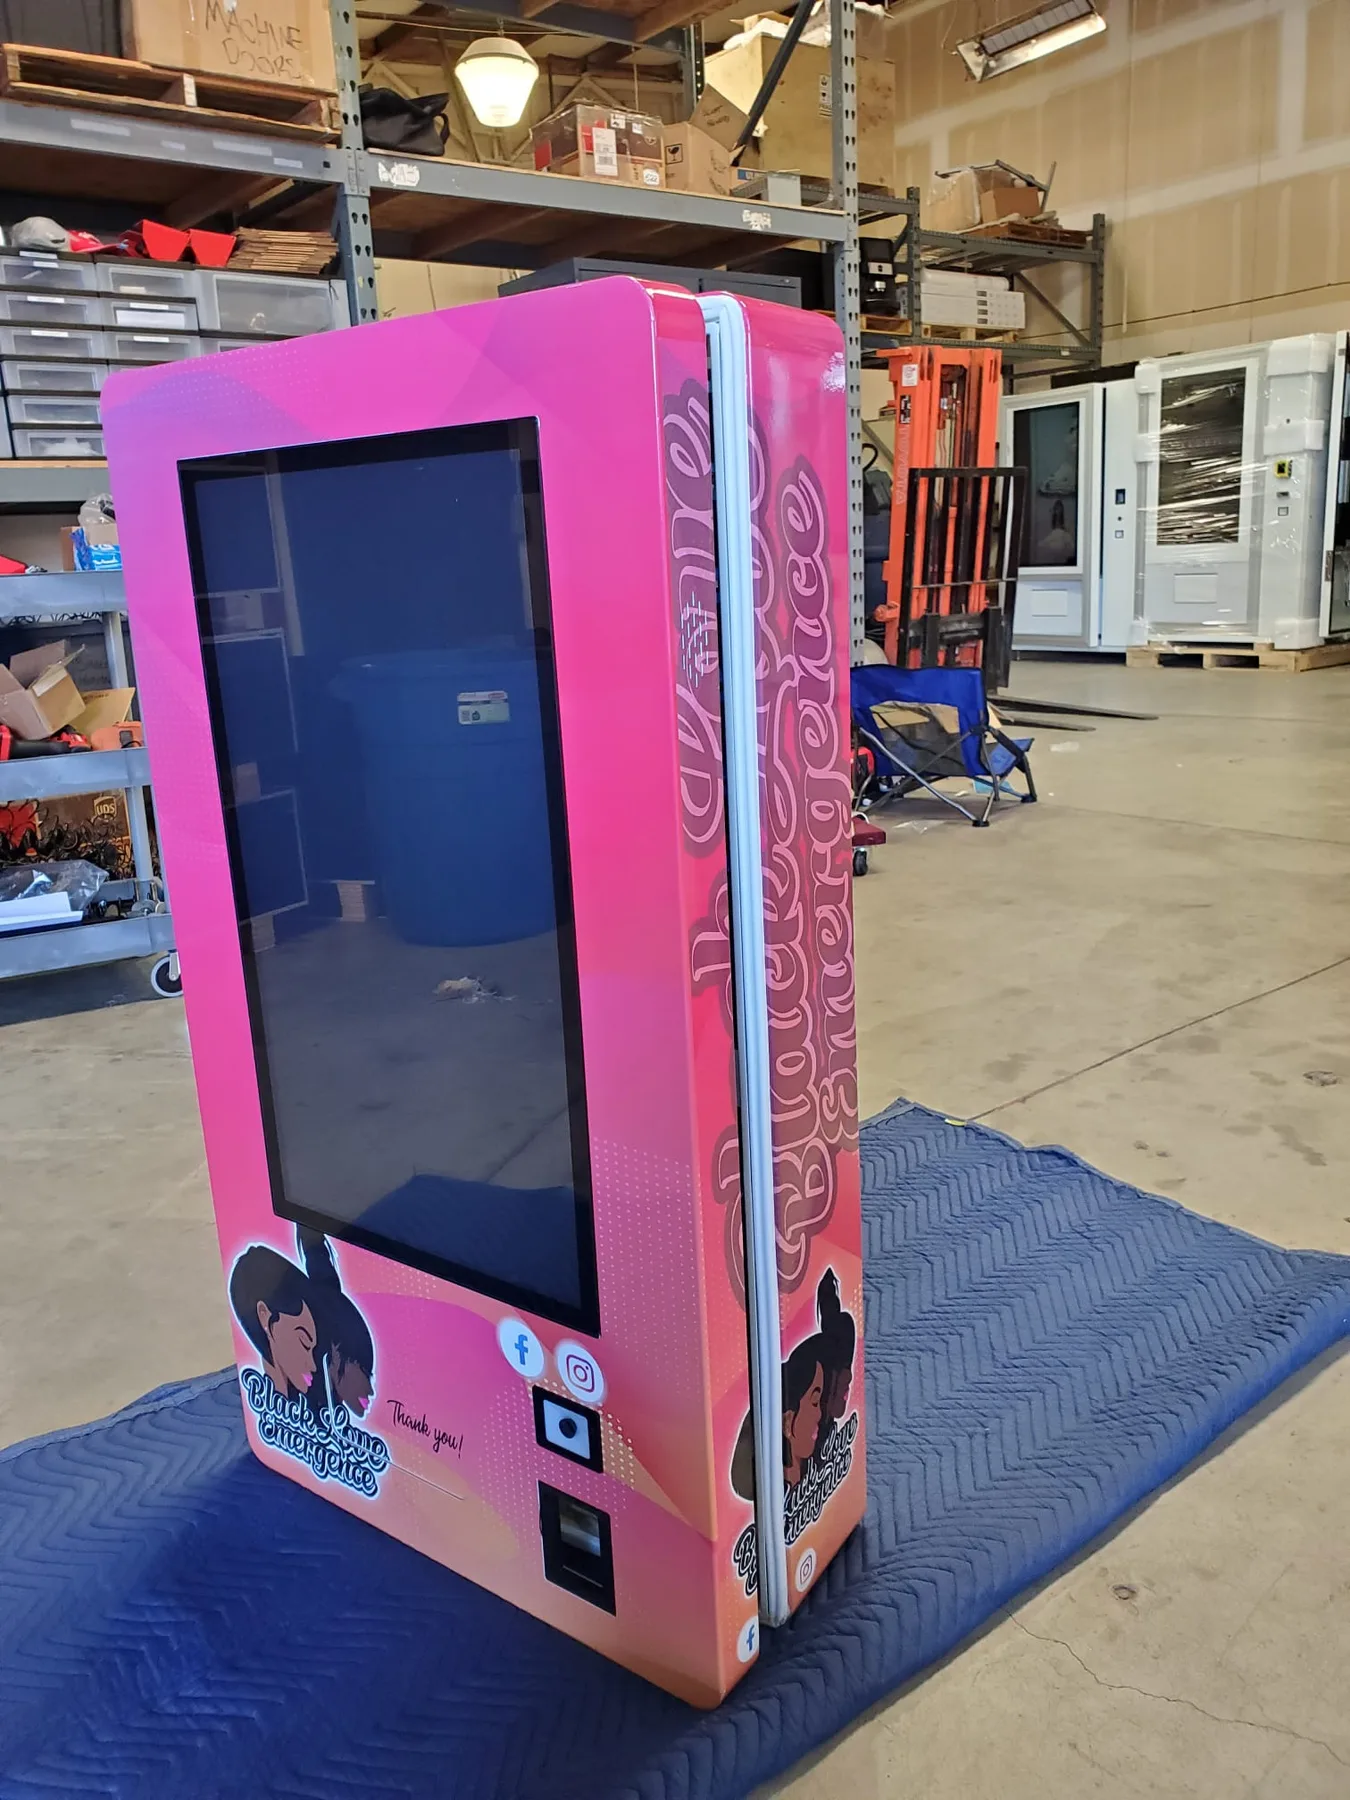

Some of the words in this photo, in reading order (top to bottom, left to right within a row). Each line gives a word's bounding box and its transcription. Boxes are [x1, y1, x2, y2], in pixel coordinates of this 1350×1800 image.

[222, 37, 304, 79] DOORS
[780, 470, 858, 1145] Emergence
[241, 1367, 317, 1436] Black
[316, 1402, 391, 1474] Love
[256, 1410, 378, 1498] Emergence
[387, 1399, 432, 1436] Thank
[433, 1427, 464, 1460] you!
